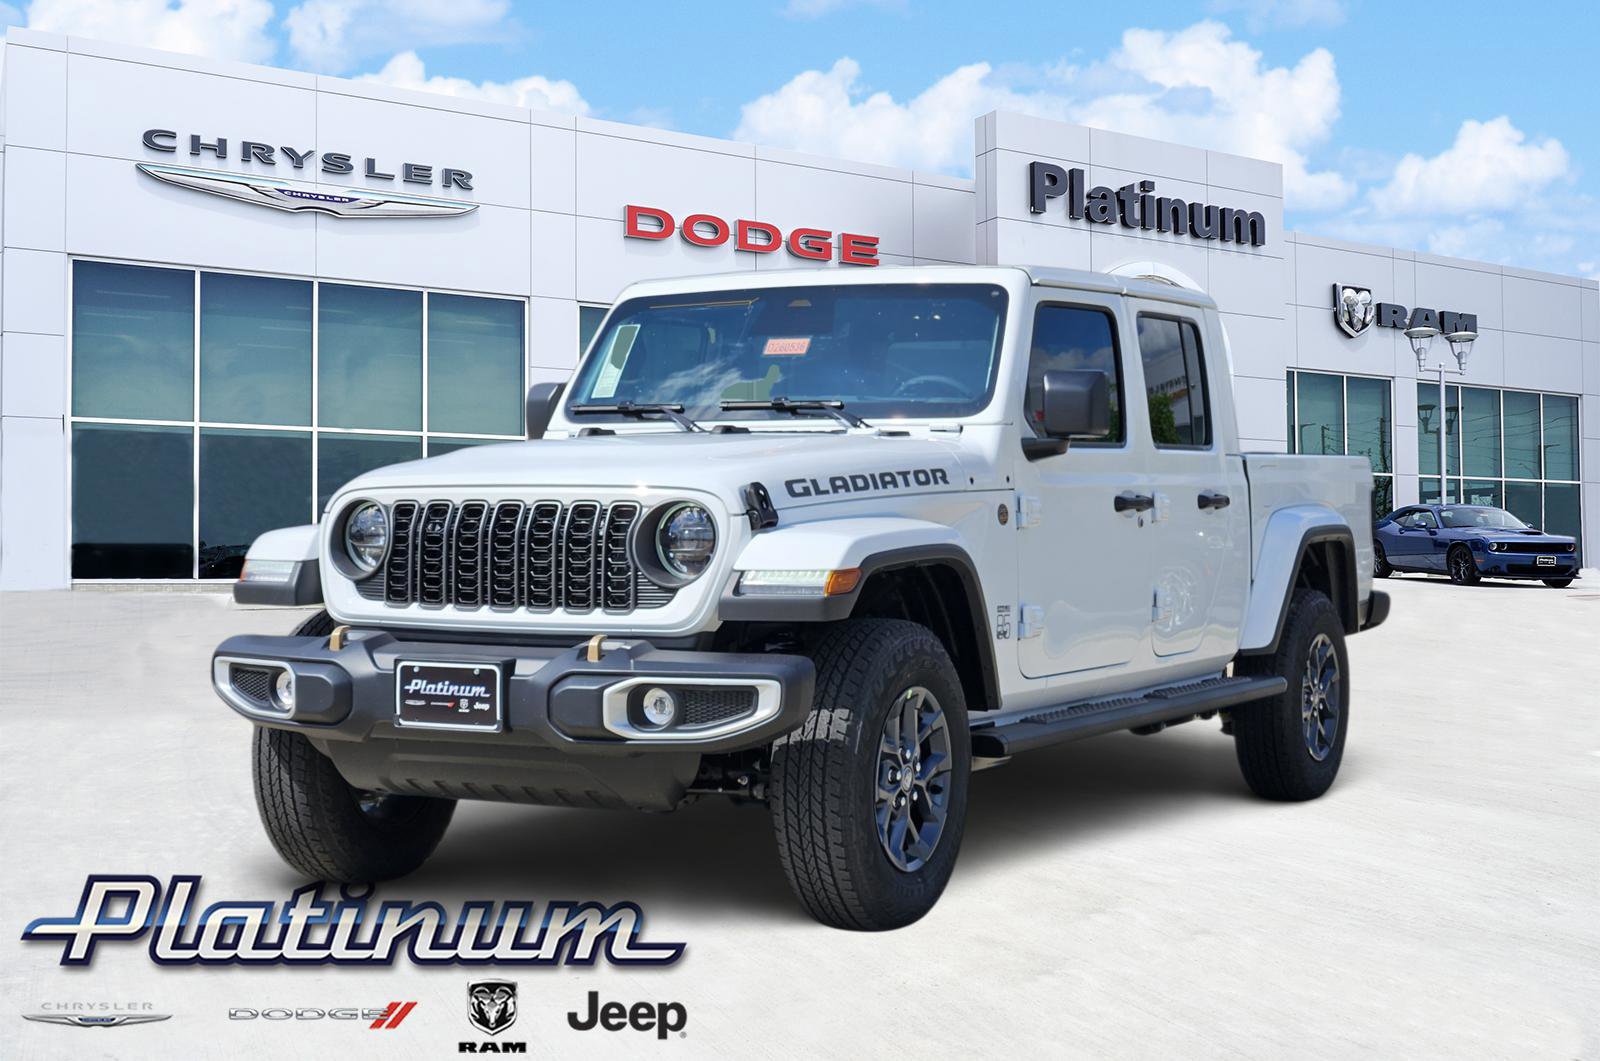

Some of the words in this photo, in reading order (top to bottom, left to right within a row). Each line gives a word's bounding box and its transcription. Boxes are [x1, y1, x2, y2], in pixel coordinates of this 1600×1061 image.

[142, 128, 475, 191] CHRYSLER
[1028, 161, 1266, 246] Platinum
[624, 204, 880, 267] DODGE
[1376, 302, 1477, 334] RAM
[785, 468, 950, 498] GLADIATOR
[404, 679, 491, 698] Platinum
